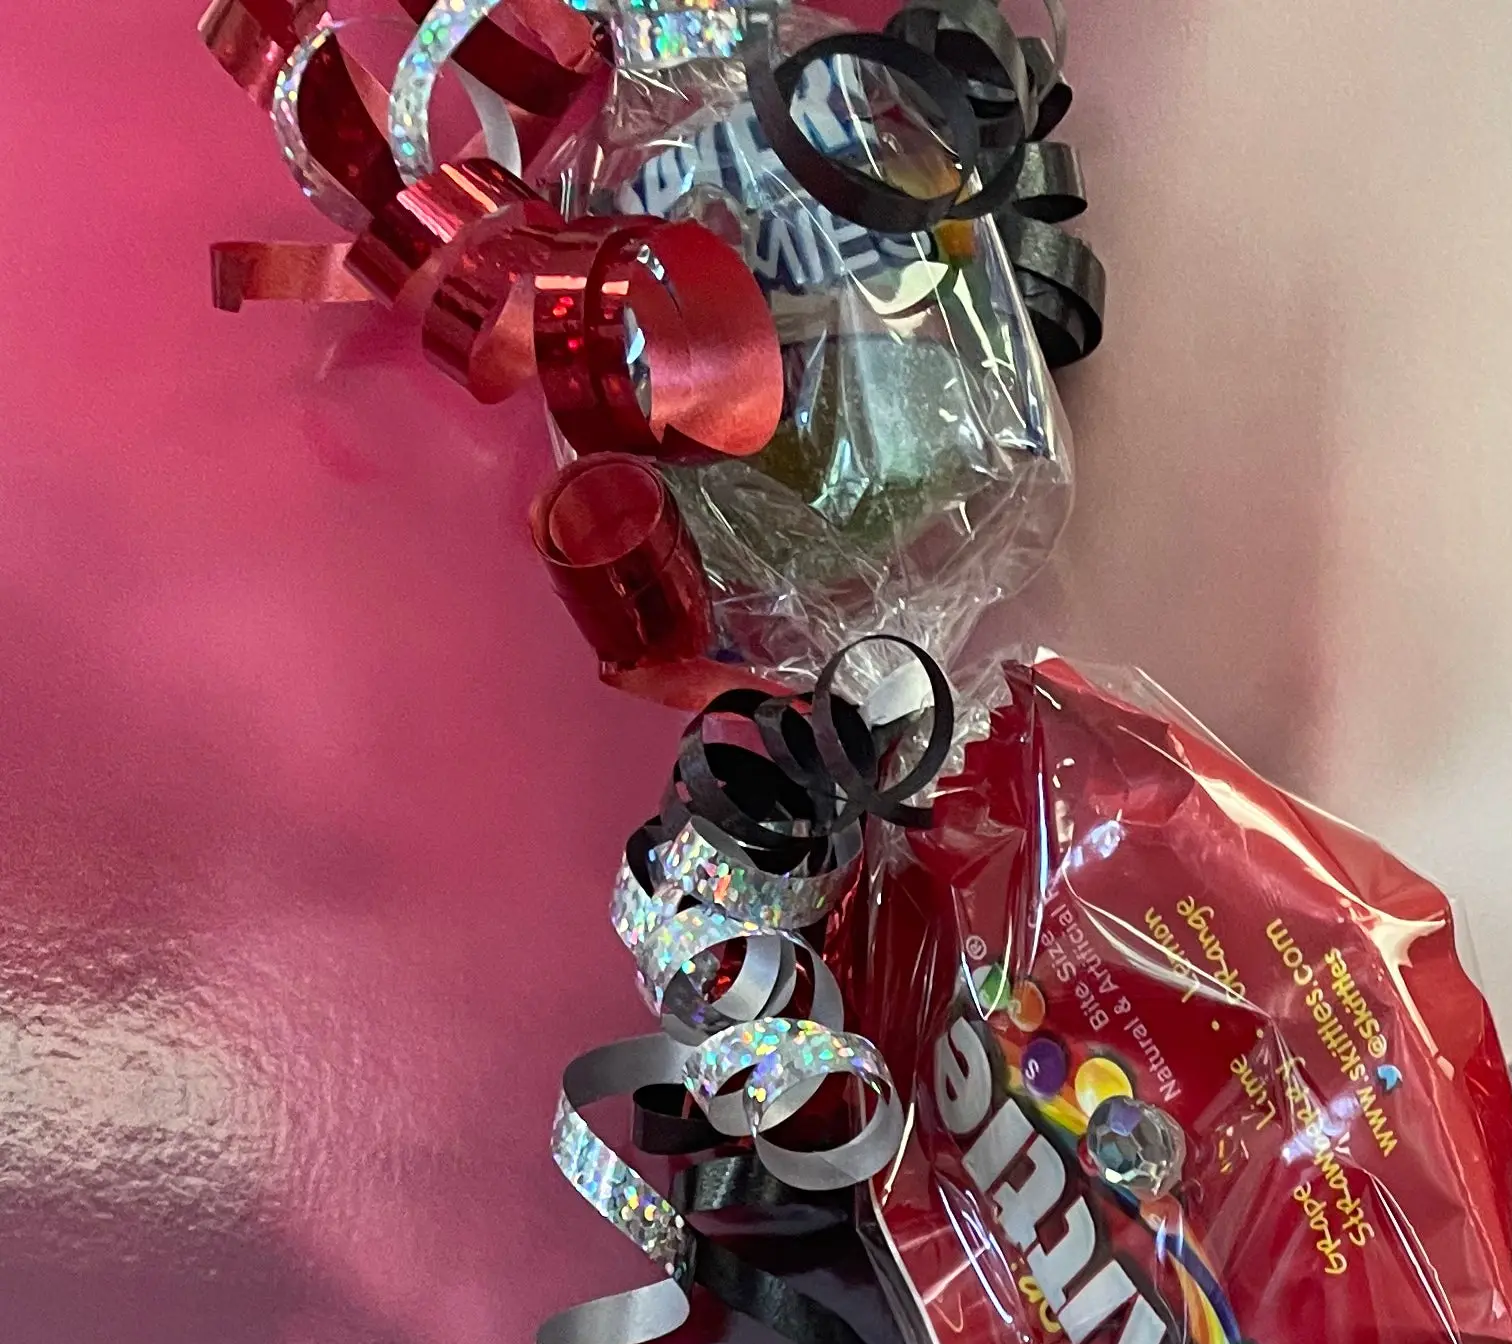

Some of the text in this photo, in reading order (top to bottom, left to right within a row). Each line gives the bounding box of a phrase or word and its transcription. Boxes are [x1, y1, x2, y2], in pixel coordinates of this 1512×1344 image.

[1041, 930, 1110, 1032] Bite Size
[1050, 903, 1182, 1101] Natural & Artificial
[1266, 917, 1398, 1157] www.skittles.com
[1323, 947, 1387, 1059] @Skittles
